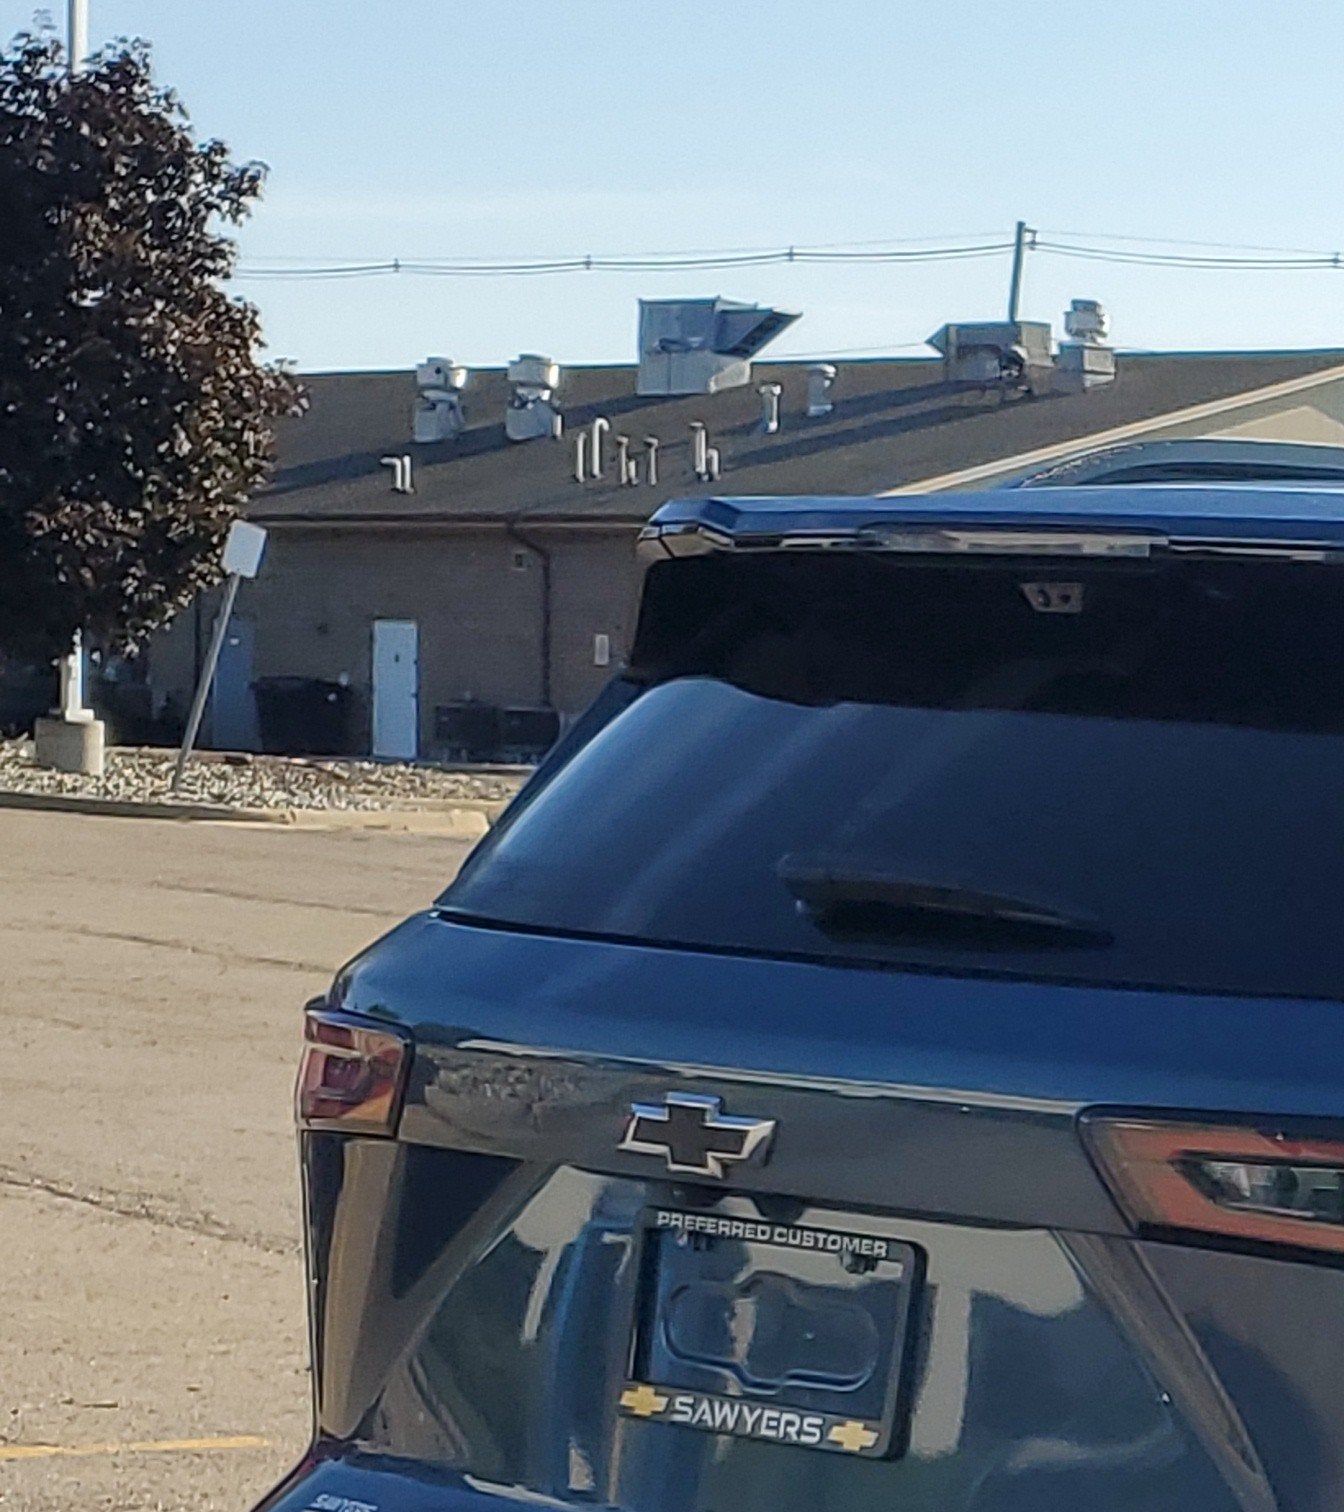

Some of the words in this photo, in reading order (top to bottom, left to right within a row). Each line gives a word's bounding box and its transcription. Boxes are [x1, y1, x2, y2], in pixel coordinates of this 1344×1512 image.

[657, 1211, 771, 1240] PREFERRED
[774, 1228, 888, 1258] CUSTOMER
[670, 1396, 823, 1443] SAWYERS
